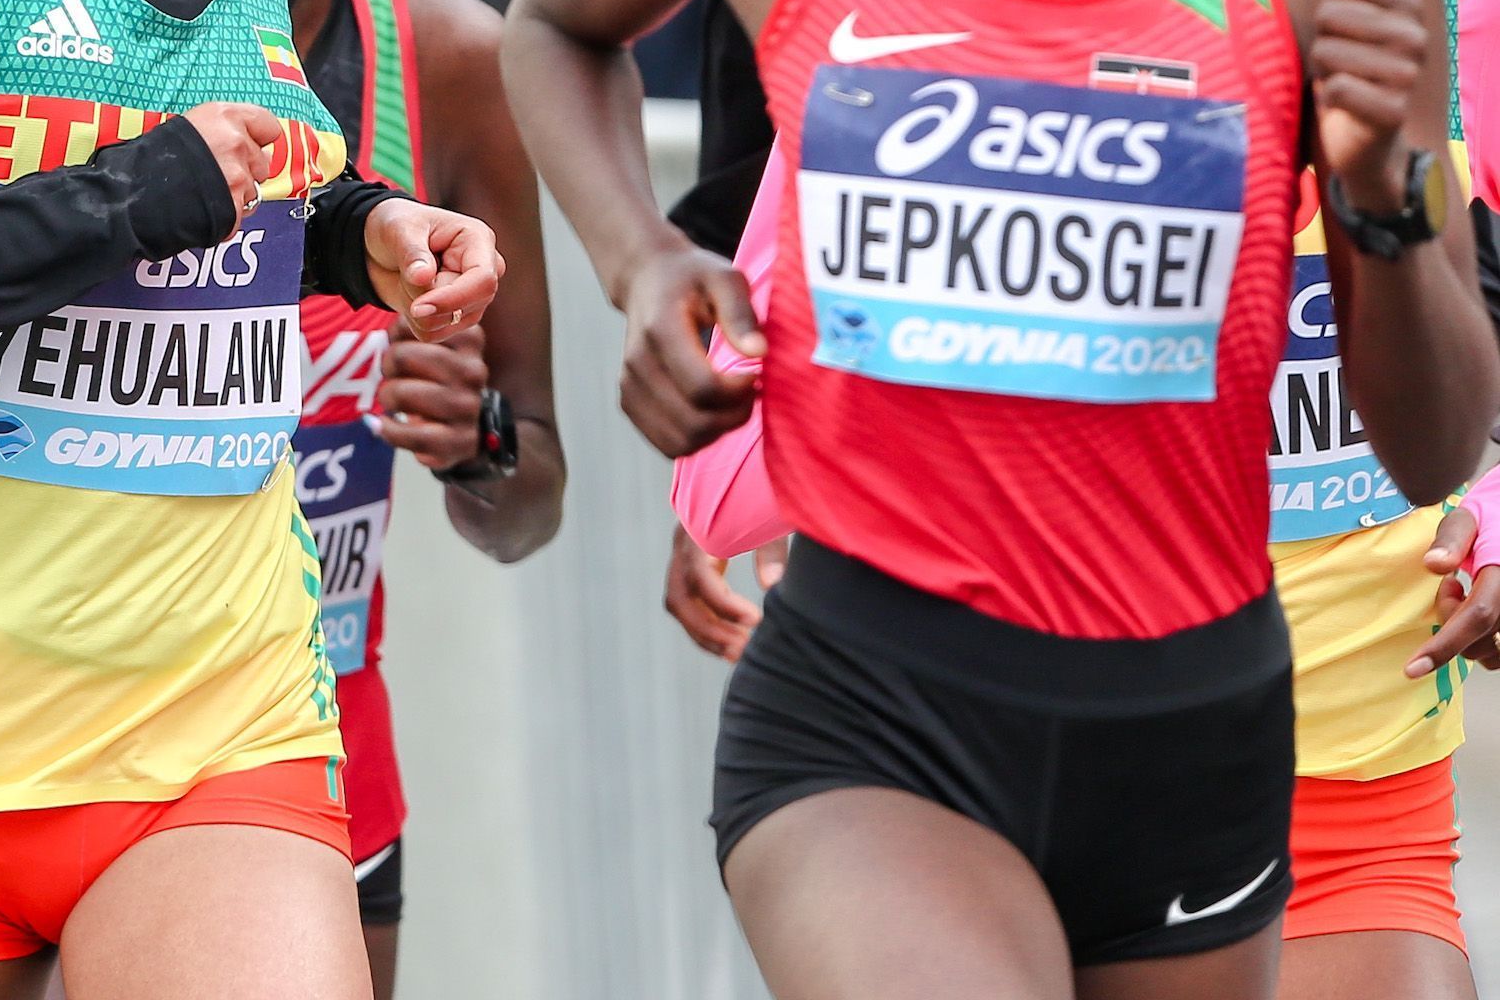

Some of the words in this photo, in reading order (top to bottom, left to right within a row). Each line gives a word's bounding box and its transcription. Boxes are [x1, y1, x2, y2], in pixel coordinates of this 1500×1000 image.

[16, 32, 114, 65] adidas
[968, 103, 1169, 186] asics
[822, 193, 1217, 309] JEPKOSGEI
[888, 306, 1087, 371] GDYNIA
[1091, 325, 1207, 376] 2020
[44, 427, 215, 469] GDYNIA
[1322, 468, 1398, 511] 202
